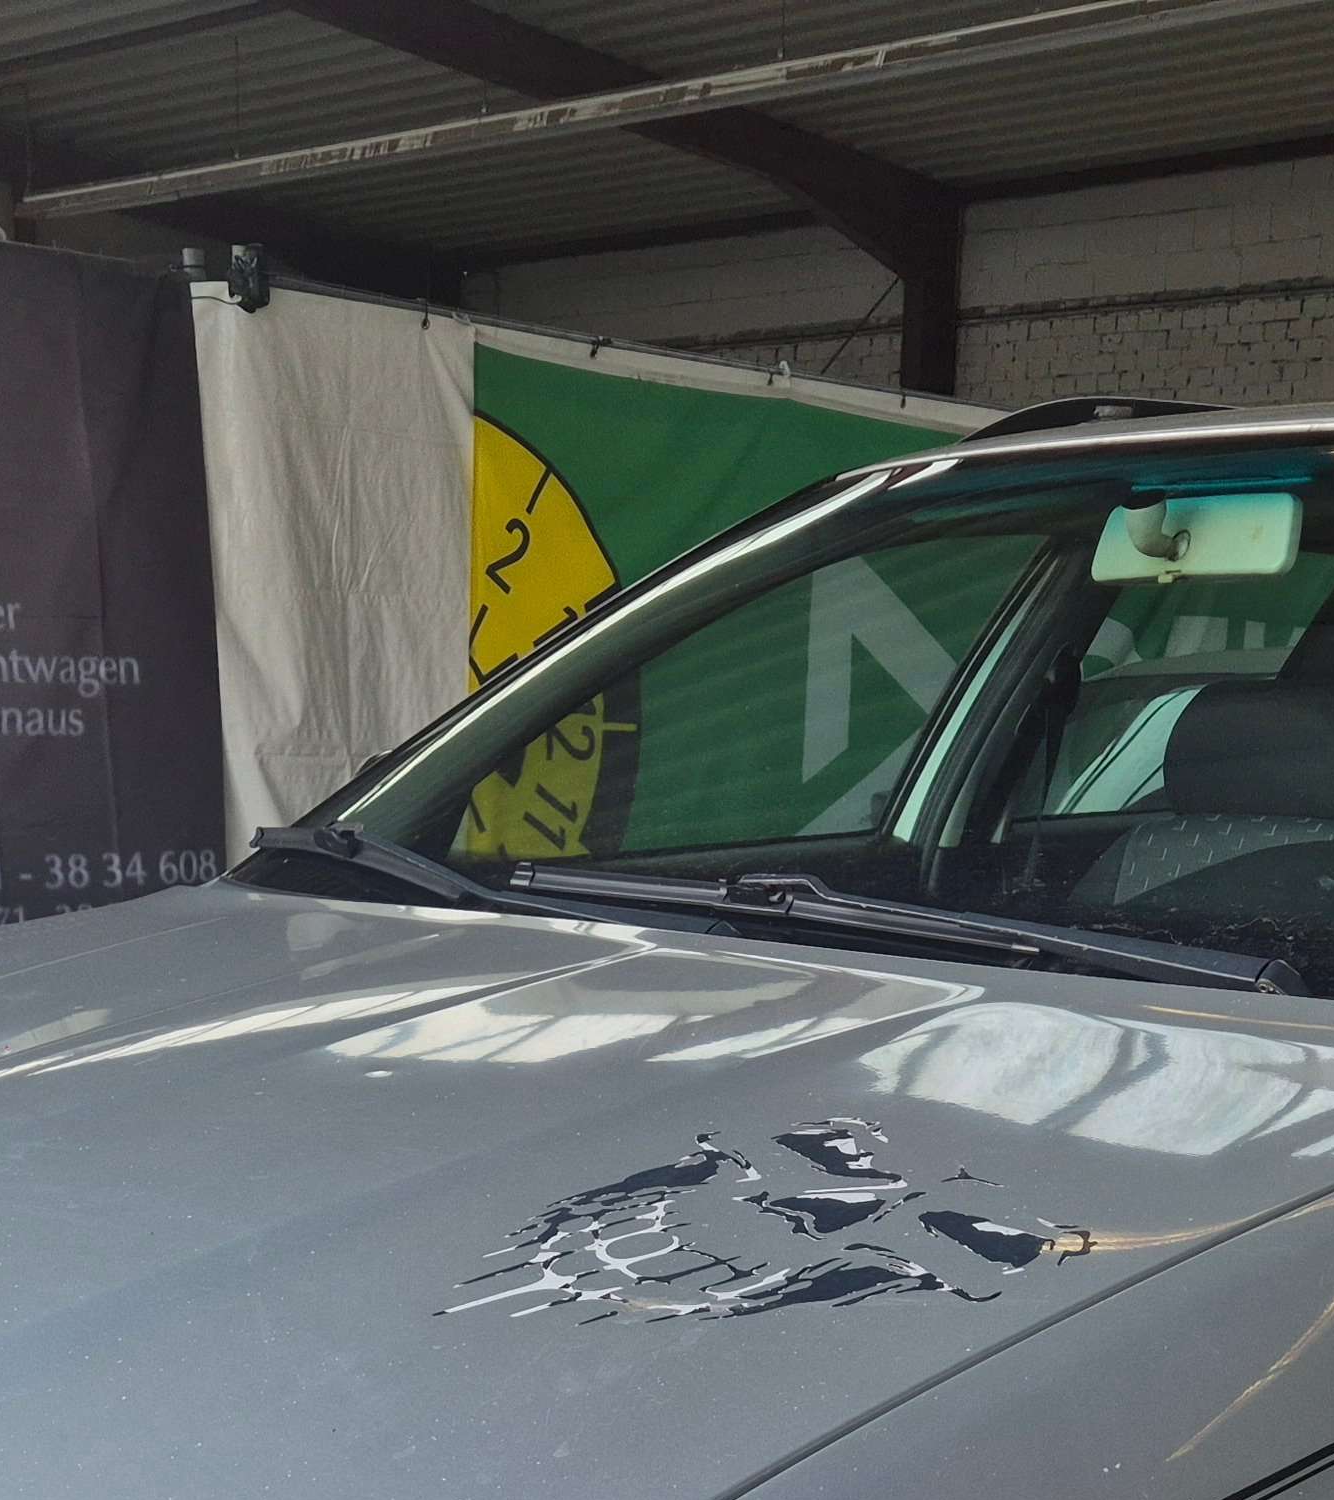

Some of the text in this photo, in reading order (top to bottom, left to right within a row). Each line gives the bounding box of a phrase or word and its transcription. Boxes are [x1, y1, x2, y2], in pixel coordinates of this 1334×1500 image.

[43, 852, 90, 891] 38
[101, 849, 147, 889] 34
[158, 847, 218, 886] 608
